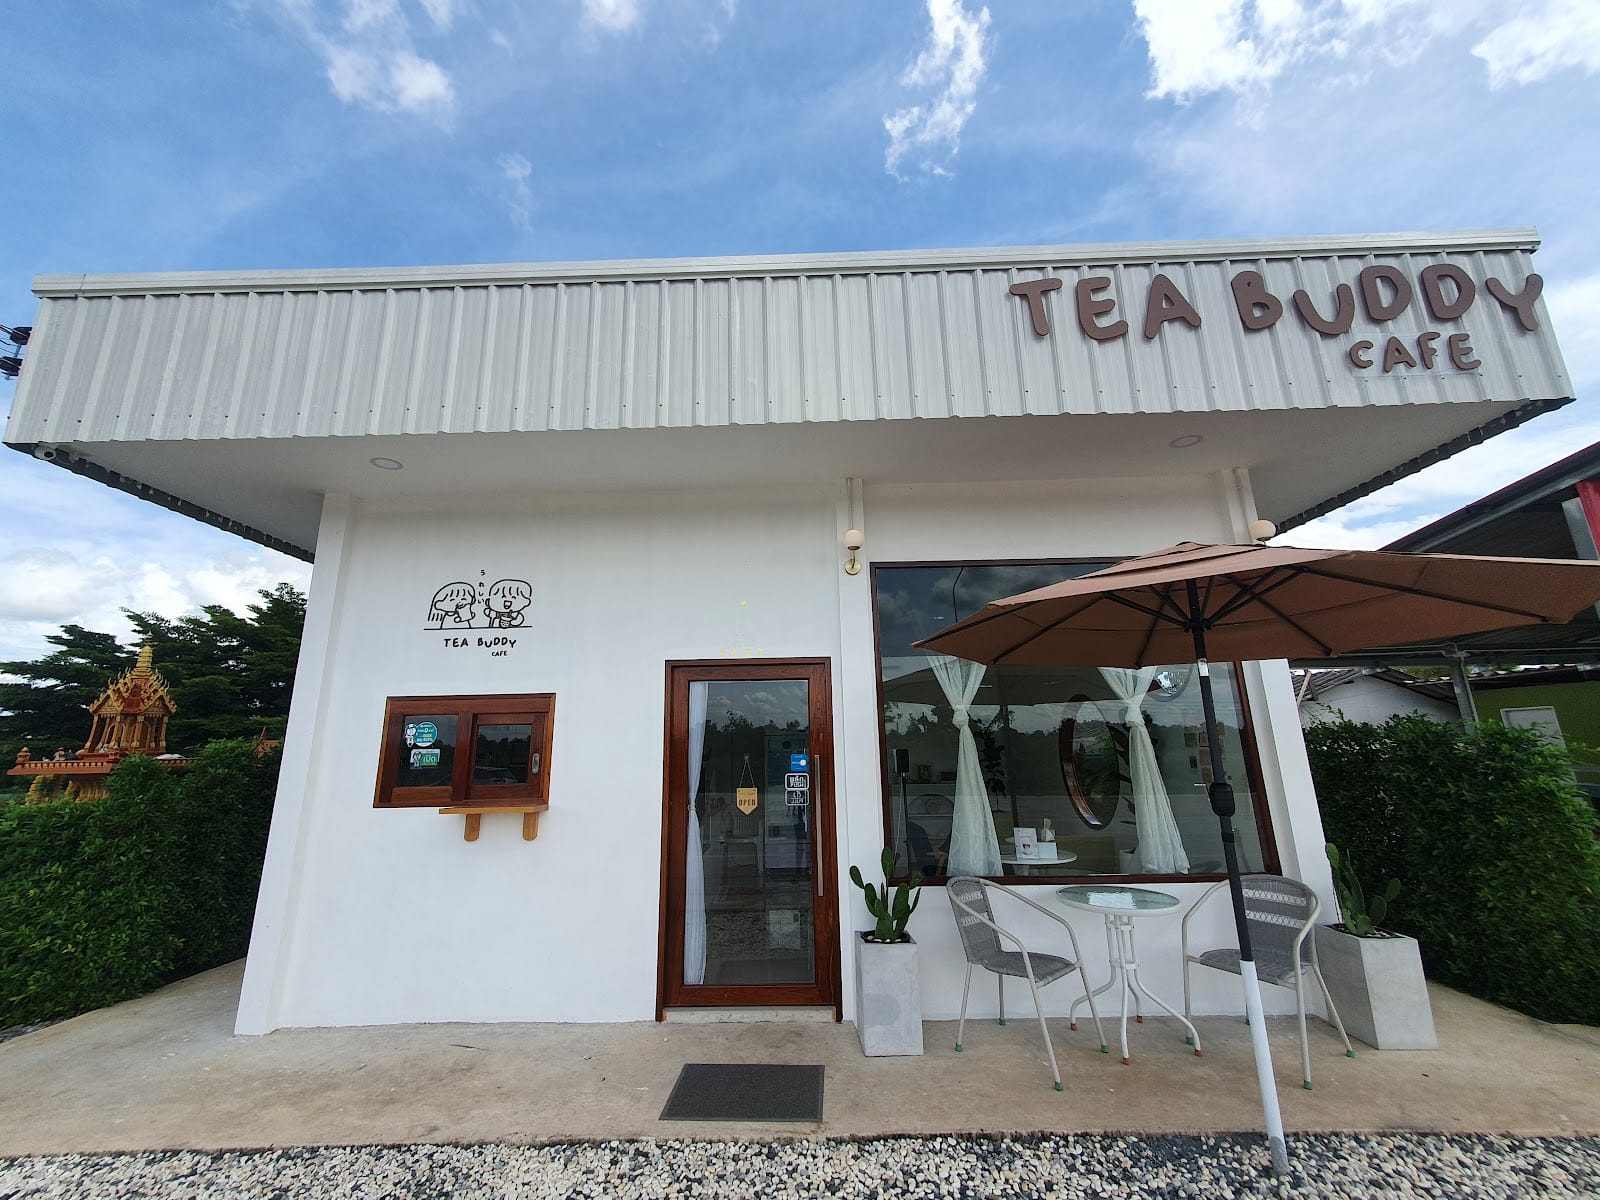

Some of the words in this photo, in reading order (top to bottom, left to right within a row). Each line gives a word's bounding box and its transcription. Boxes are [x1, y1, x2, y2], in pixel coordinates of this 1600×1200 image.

[1009, 273, 1202, 340] TEA
[1230, 263, 1543, 336] BUDDY
[1349, 331, 1481, 373] CAFE
[443, 637, 469, 648] TEA
[477, 637, 517, 649] BUDDY
[738, 799, 756, 807] OPEN
